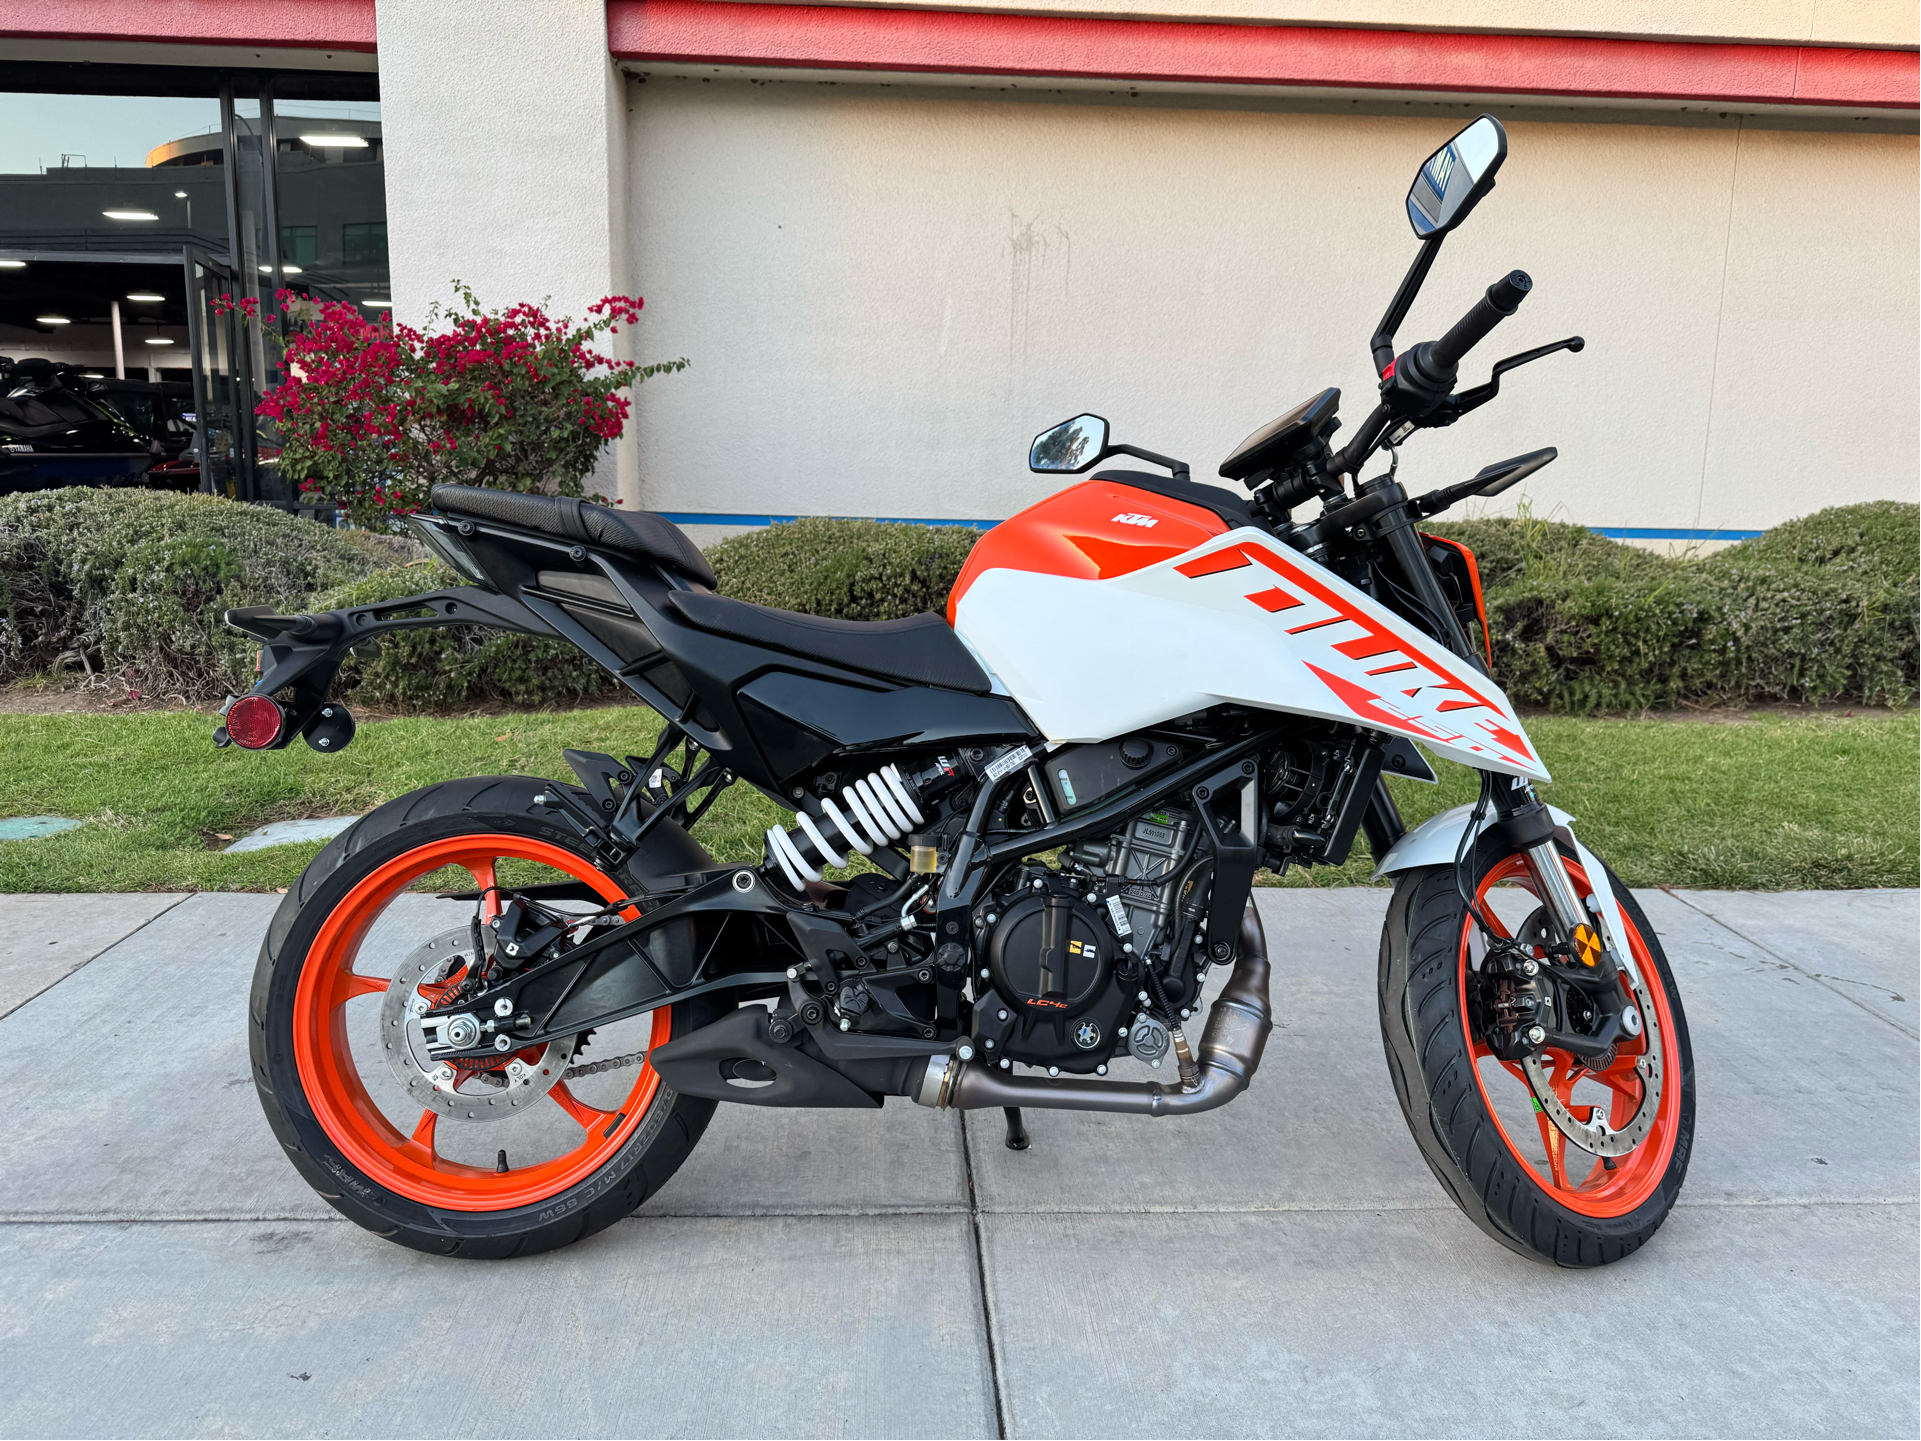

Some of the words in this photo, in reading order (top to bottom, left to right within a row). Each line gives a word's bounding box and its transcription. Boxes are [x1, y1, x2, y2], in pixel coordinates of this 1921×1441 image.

[1110, 512, 1160, 529] KTM
[1188, 547, 1514, 742] DUKE
[538, 826, 600, 861] STEE
[619, 1087, 675, 1171] 0/60ZR17
[1674, 1128, 1691, 1174] MRF
[584, 1170, 617, 1199] M/C
[538, 1197, 579, 1222] 66W
